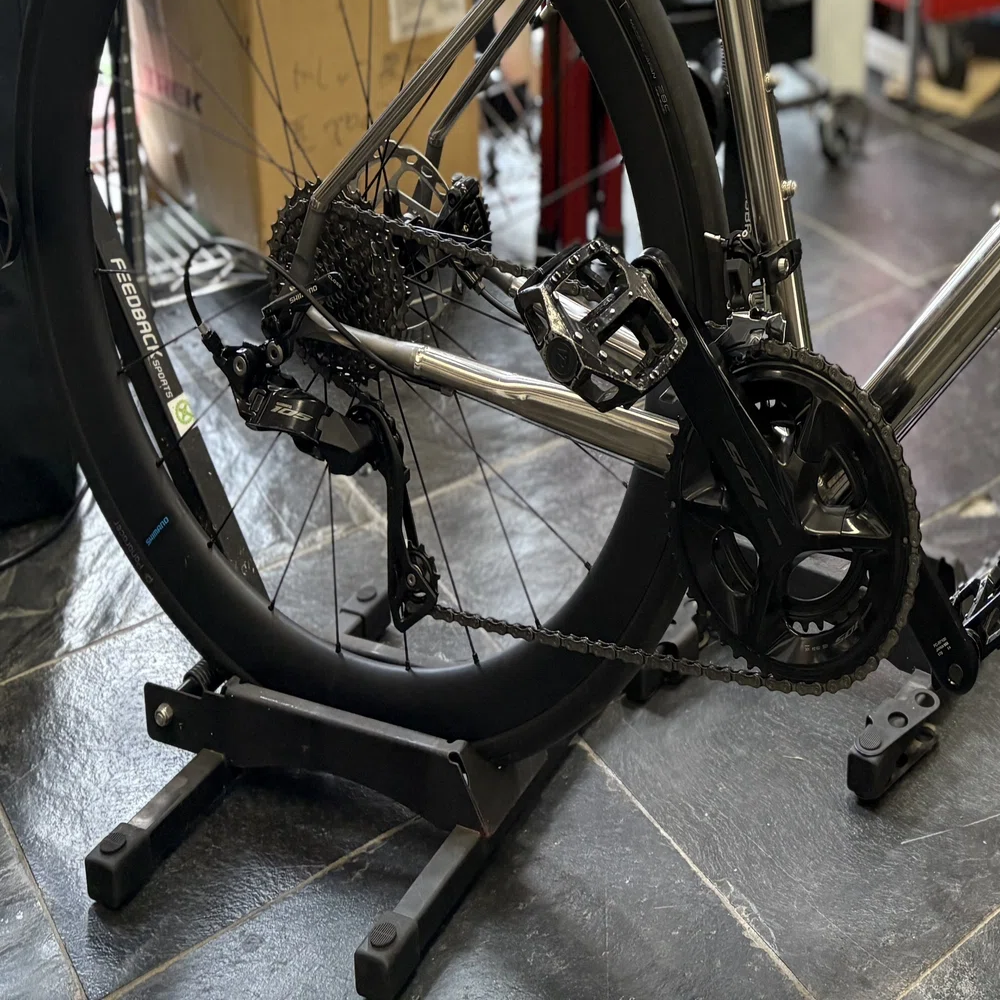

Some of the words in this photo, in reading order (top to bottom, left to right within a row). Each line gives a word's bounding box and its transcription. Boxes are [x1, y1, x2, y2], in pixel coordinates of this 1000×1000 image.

[110, 257, 163, 359] FEEDBACK
[152, 358, 174, 399] SPORTS
[270, 402, 313, 422] 105
[145, 516, 170, 547] SHIMANO
